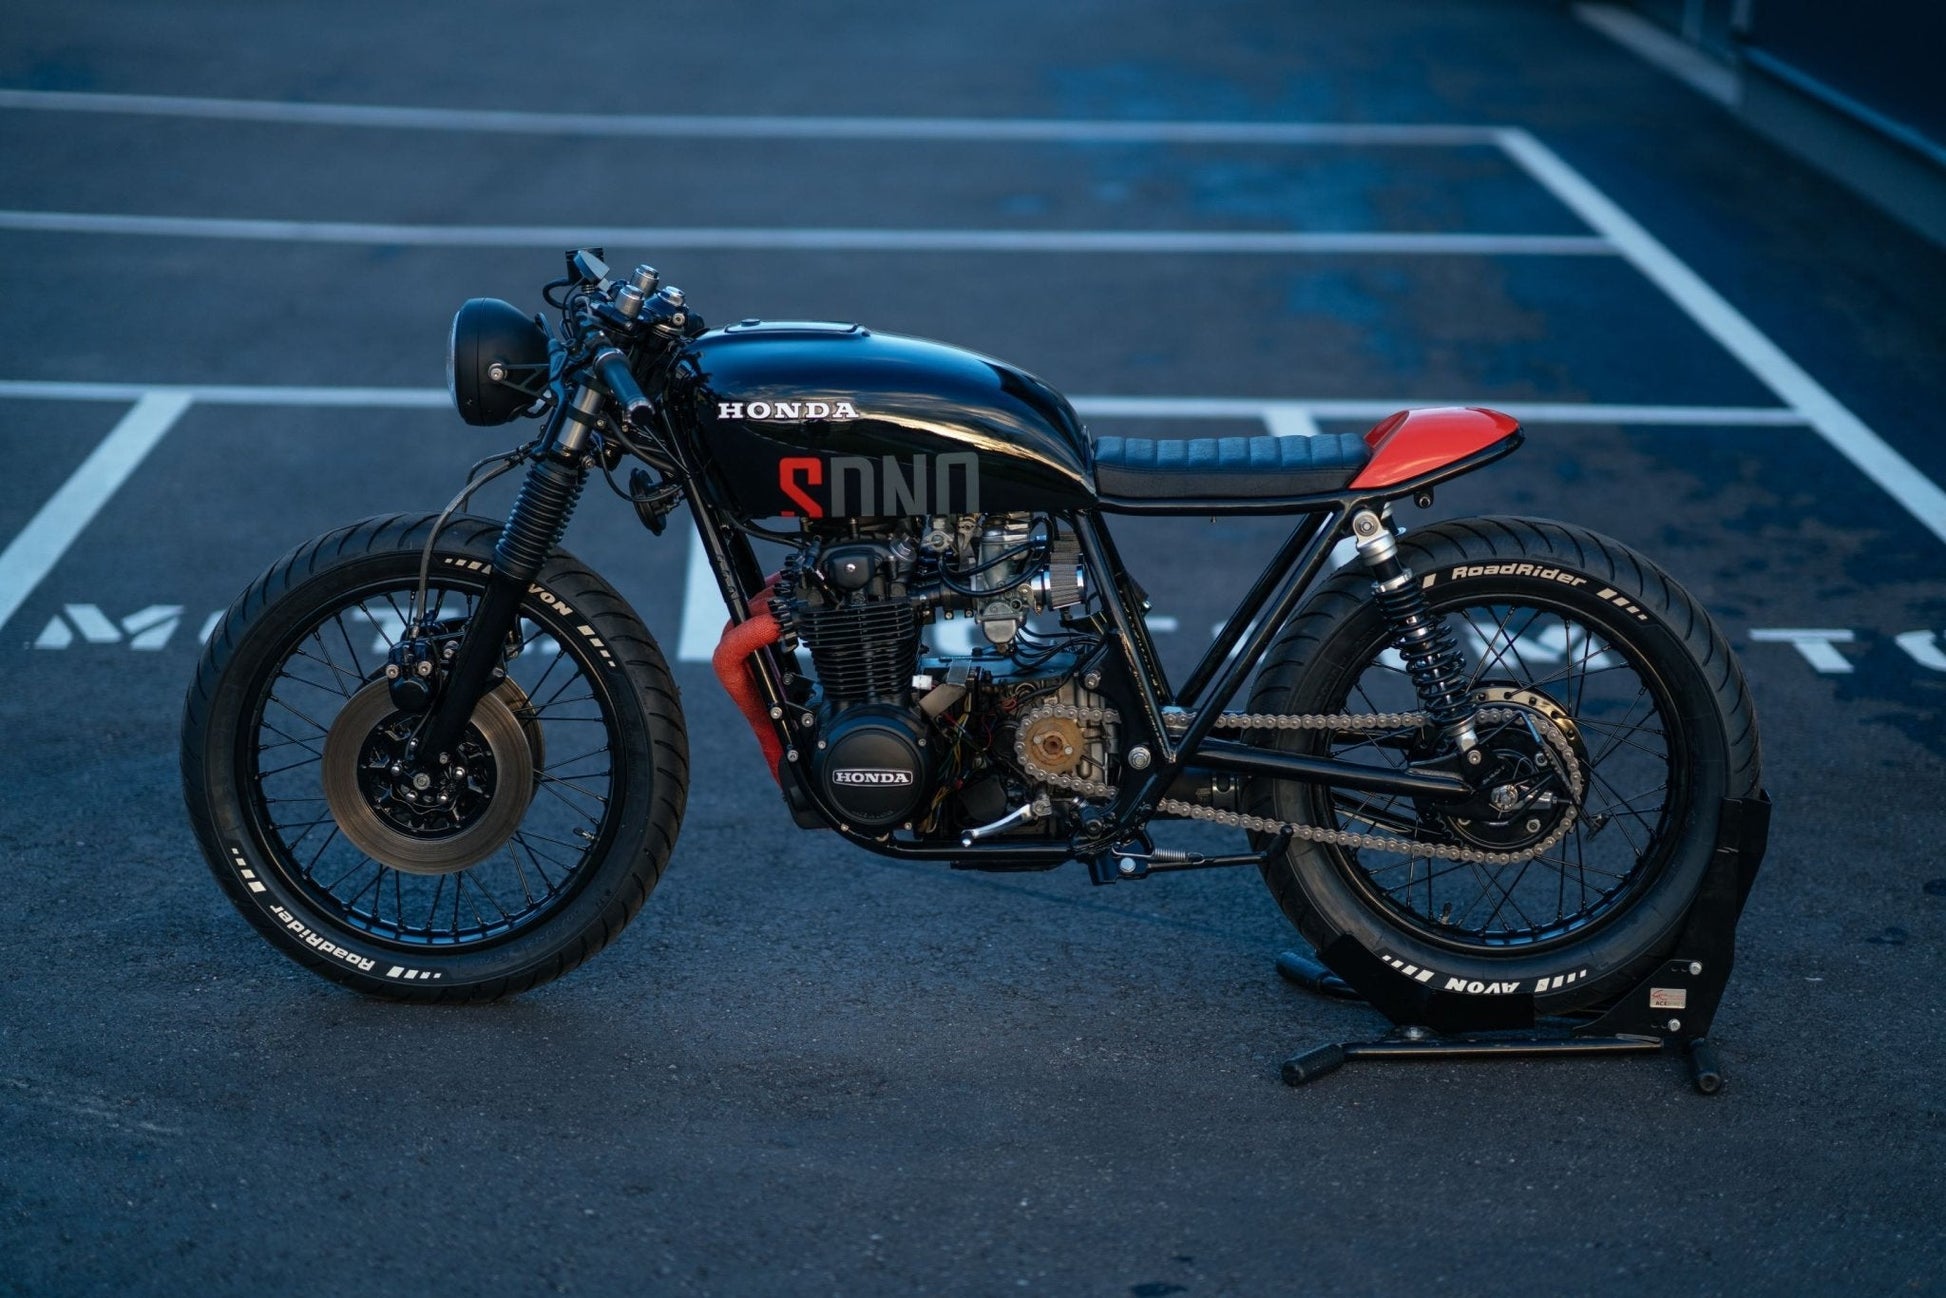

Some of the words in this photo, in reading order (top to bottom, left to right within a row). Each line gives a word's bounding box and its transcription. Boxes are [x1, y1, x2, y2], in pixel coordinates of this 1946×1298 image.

[717, 401, 859, 419] HONDA
[1451, 563, 1588, 587] RoadRider
[527, 583, 573, 616] VON
[836, 772, 909, 783] HONDA
[269, 904, 376, 971] RoadRider
[1444, 977, 1521, 994] AVON
